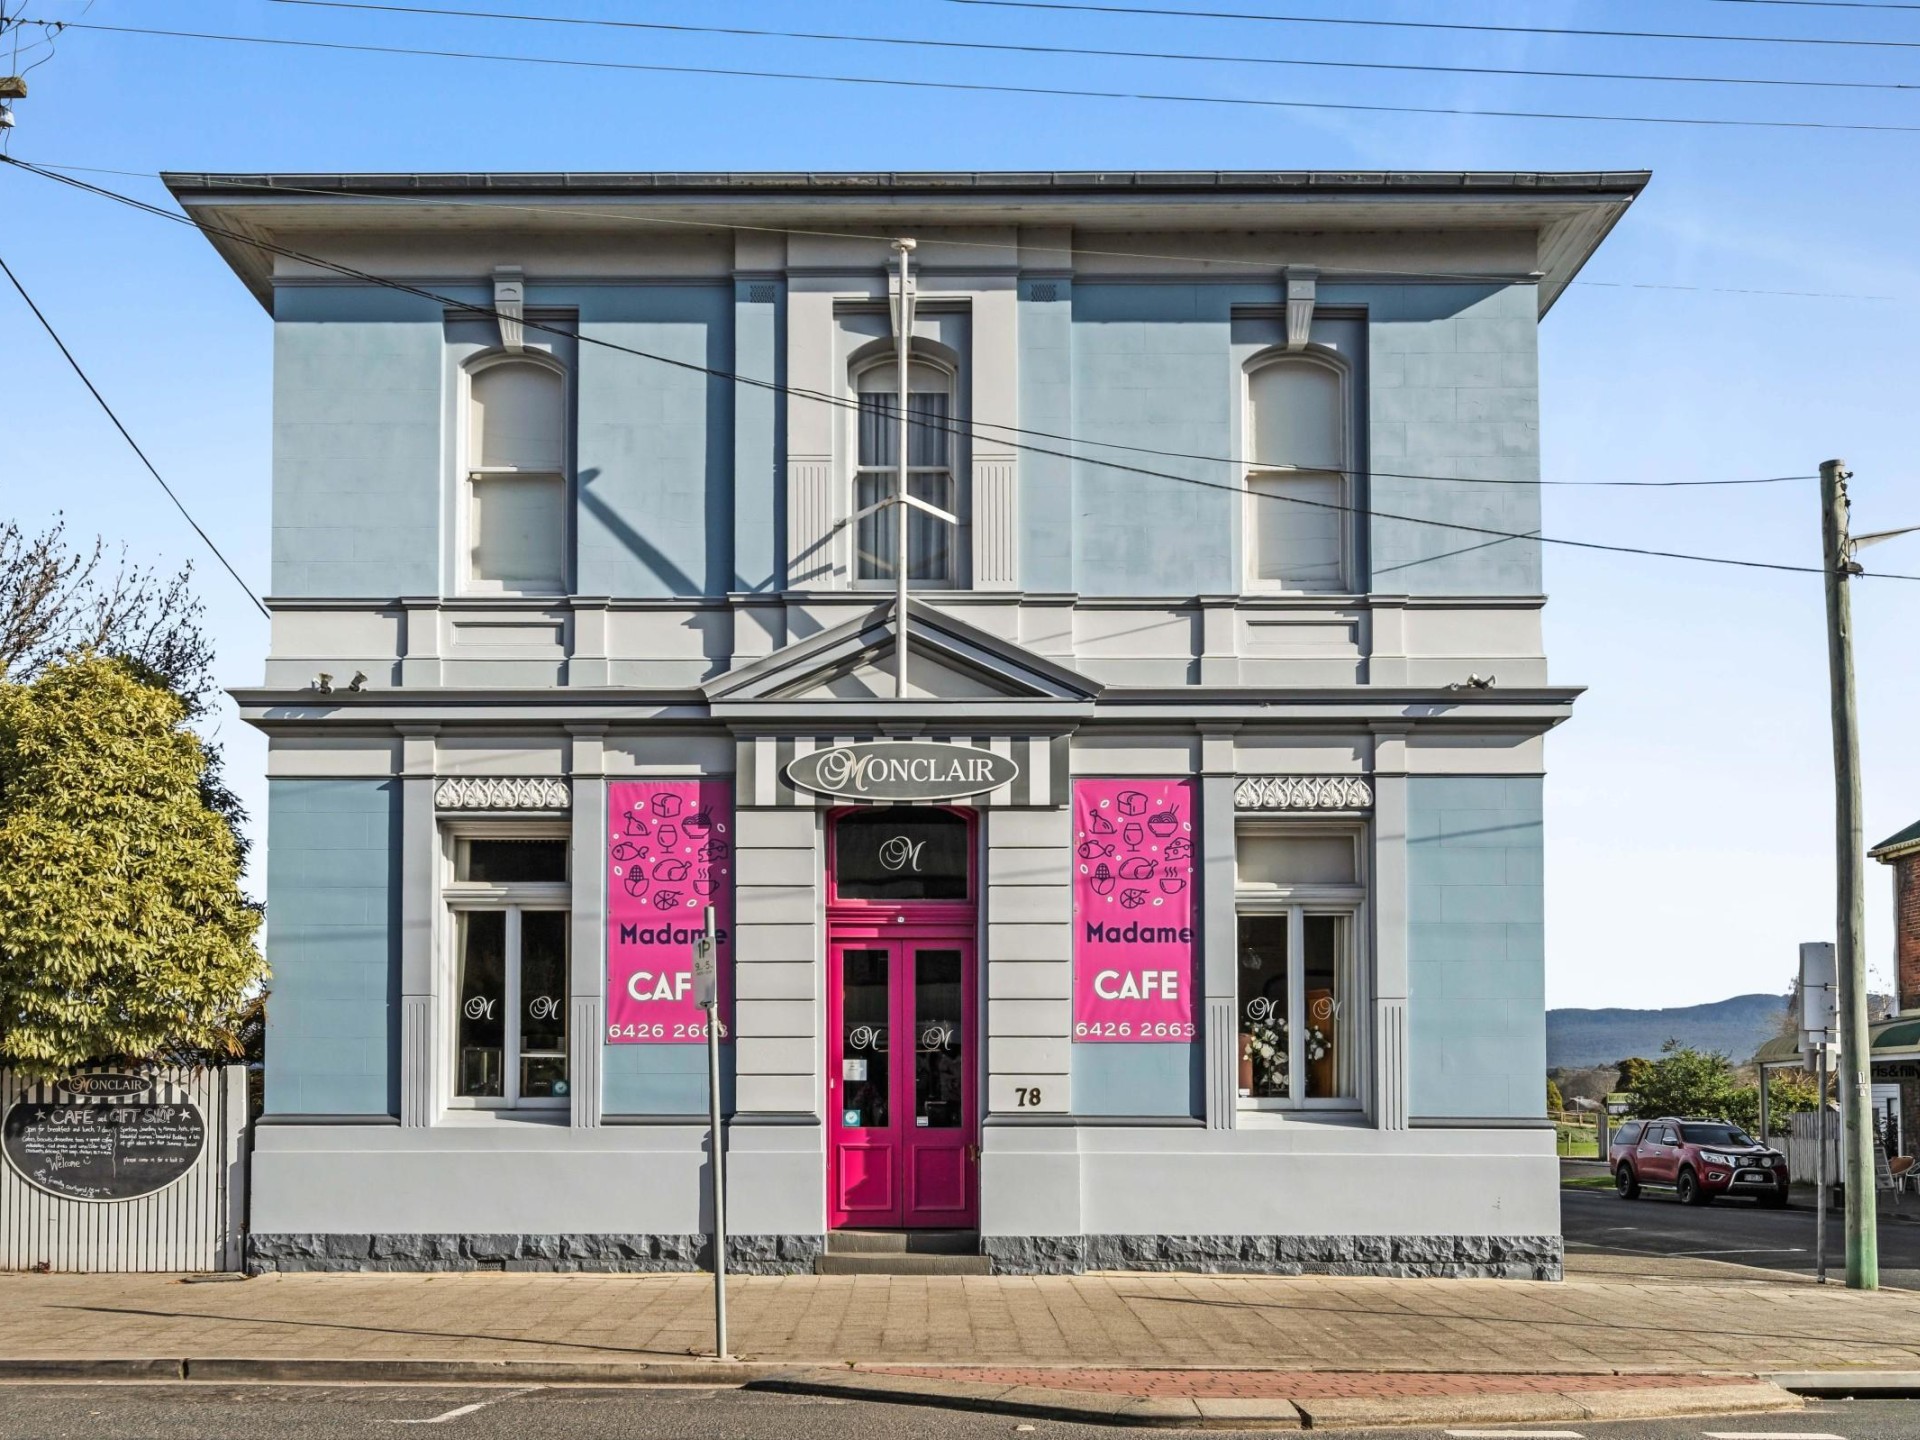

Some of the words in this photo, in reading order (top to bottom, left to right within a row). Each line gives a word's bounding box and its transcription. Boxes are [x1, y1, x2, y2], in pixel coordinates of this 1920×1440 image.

[816, 749, 995, 791] MONCLAIR
[621, 923, 728, 945] Madame
[1087, 921, 1194, 943] Madame
[628, 971, 691, 1001] CAF
[1094, 970, 1178, 1000] CAFE
[608, 1023, 664, 1038] 6426
[1076, 1022, 1131, 1037] 6426
[1140, 1022, 1196, 1037] 2663
[69, 1076, 142, 1094] MONCLAIR
[1016, 1088, 1041, 1107] 78
[51, 1110, 94, 1125] CAFE
[109, 1108, 141, 1123] GIFT
[142, 1108, 175, 1123] SHOP
[46, 1152, 80, 1171] Welcome
